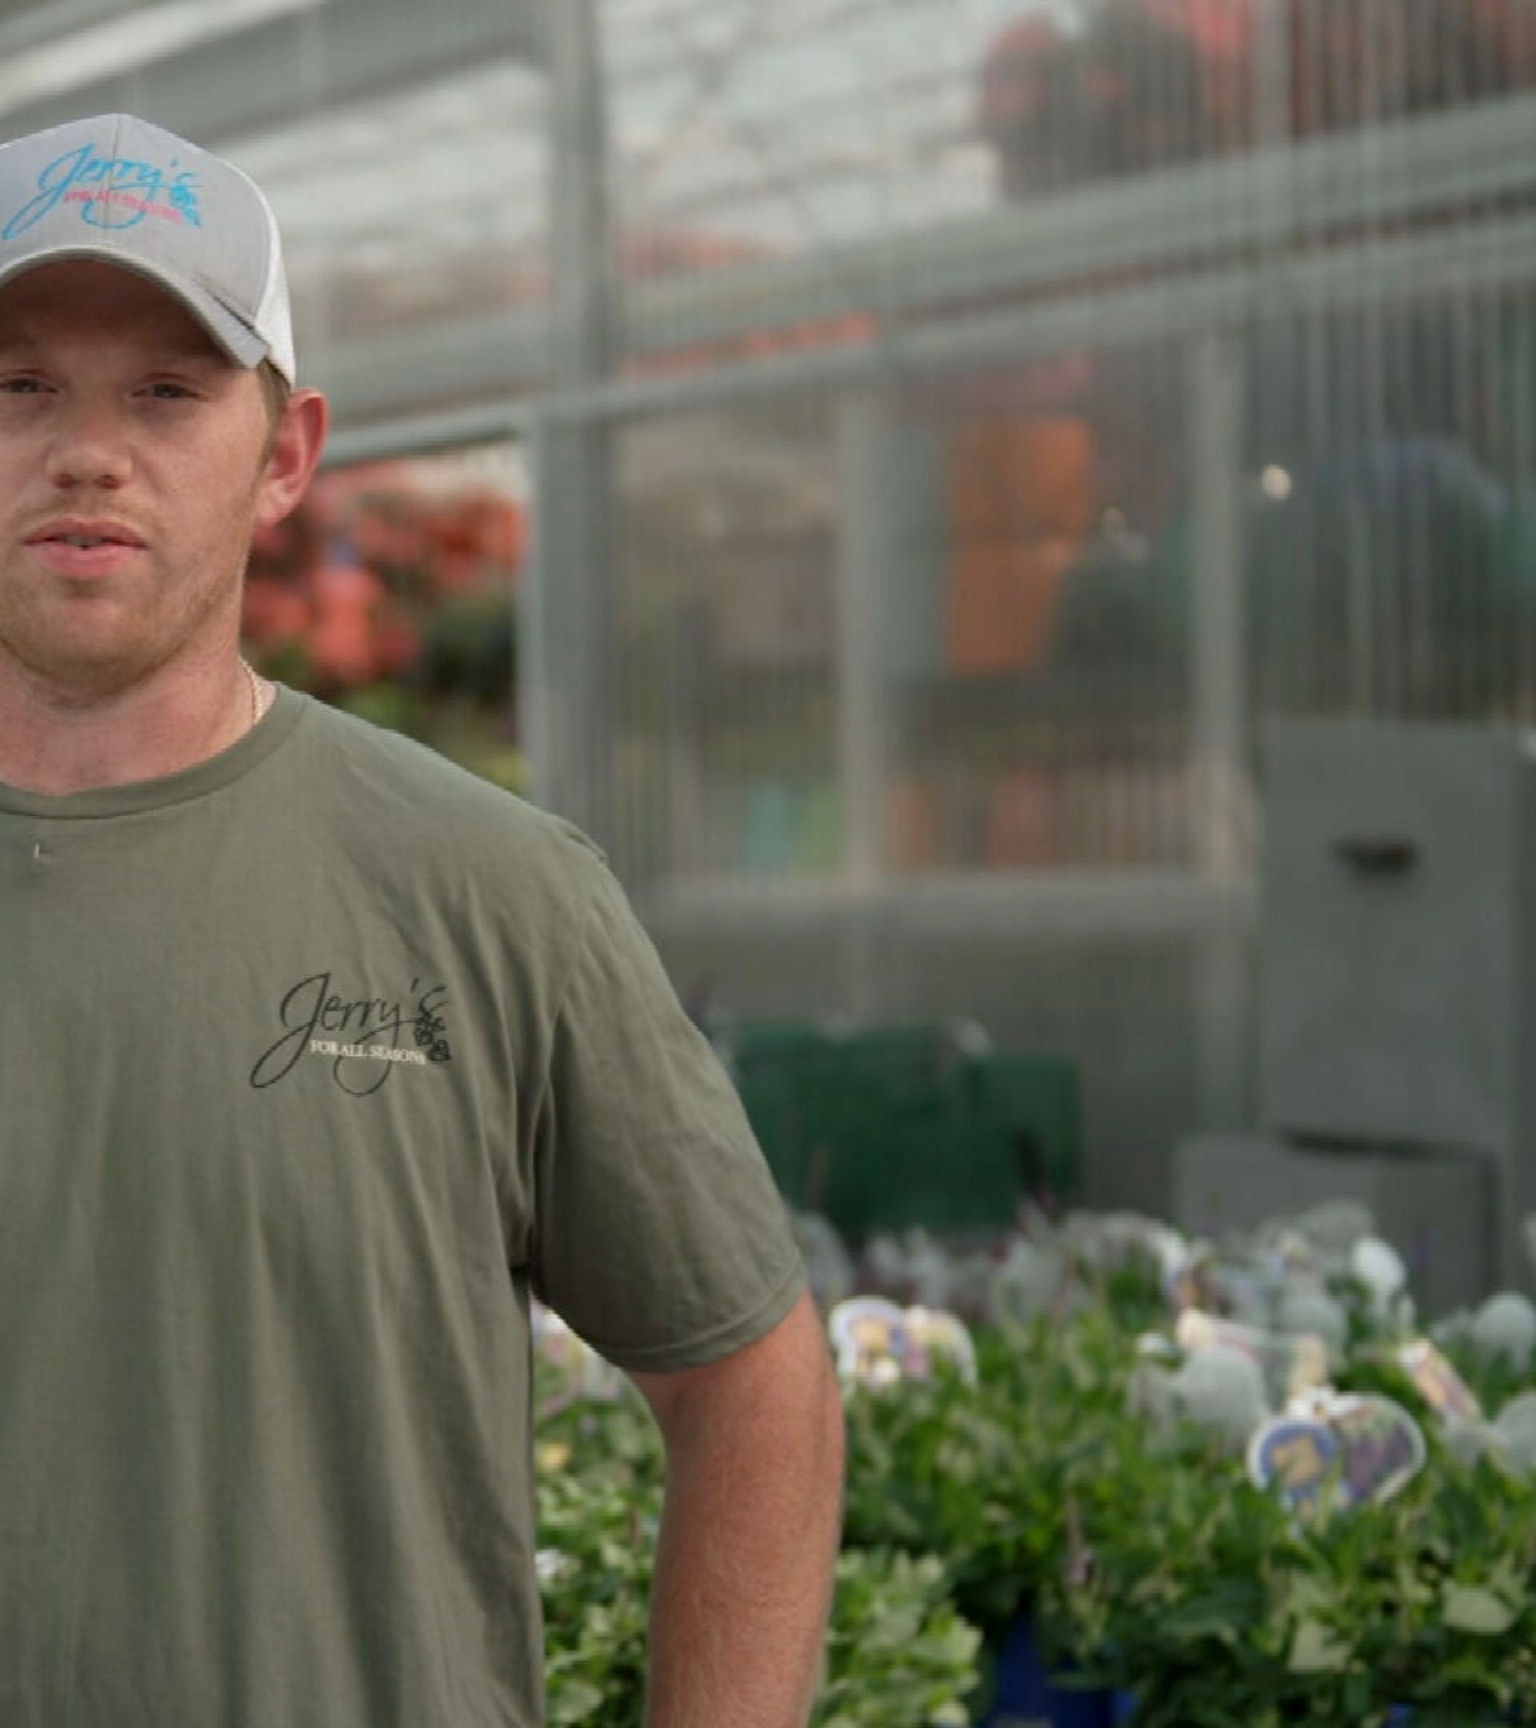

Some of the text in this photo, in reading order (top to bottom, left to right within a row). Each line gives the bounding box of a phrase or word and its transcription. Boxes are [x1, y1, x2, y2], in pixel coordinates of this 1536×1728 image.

[1, 143, 202, 240] Jerry's
[250, 972, 449, 1097] Jerry's
[310, 1039, 337, 1055] FOR
[340, 1044, 368, 1058] ALL
